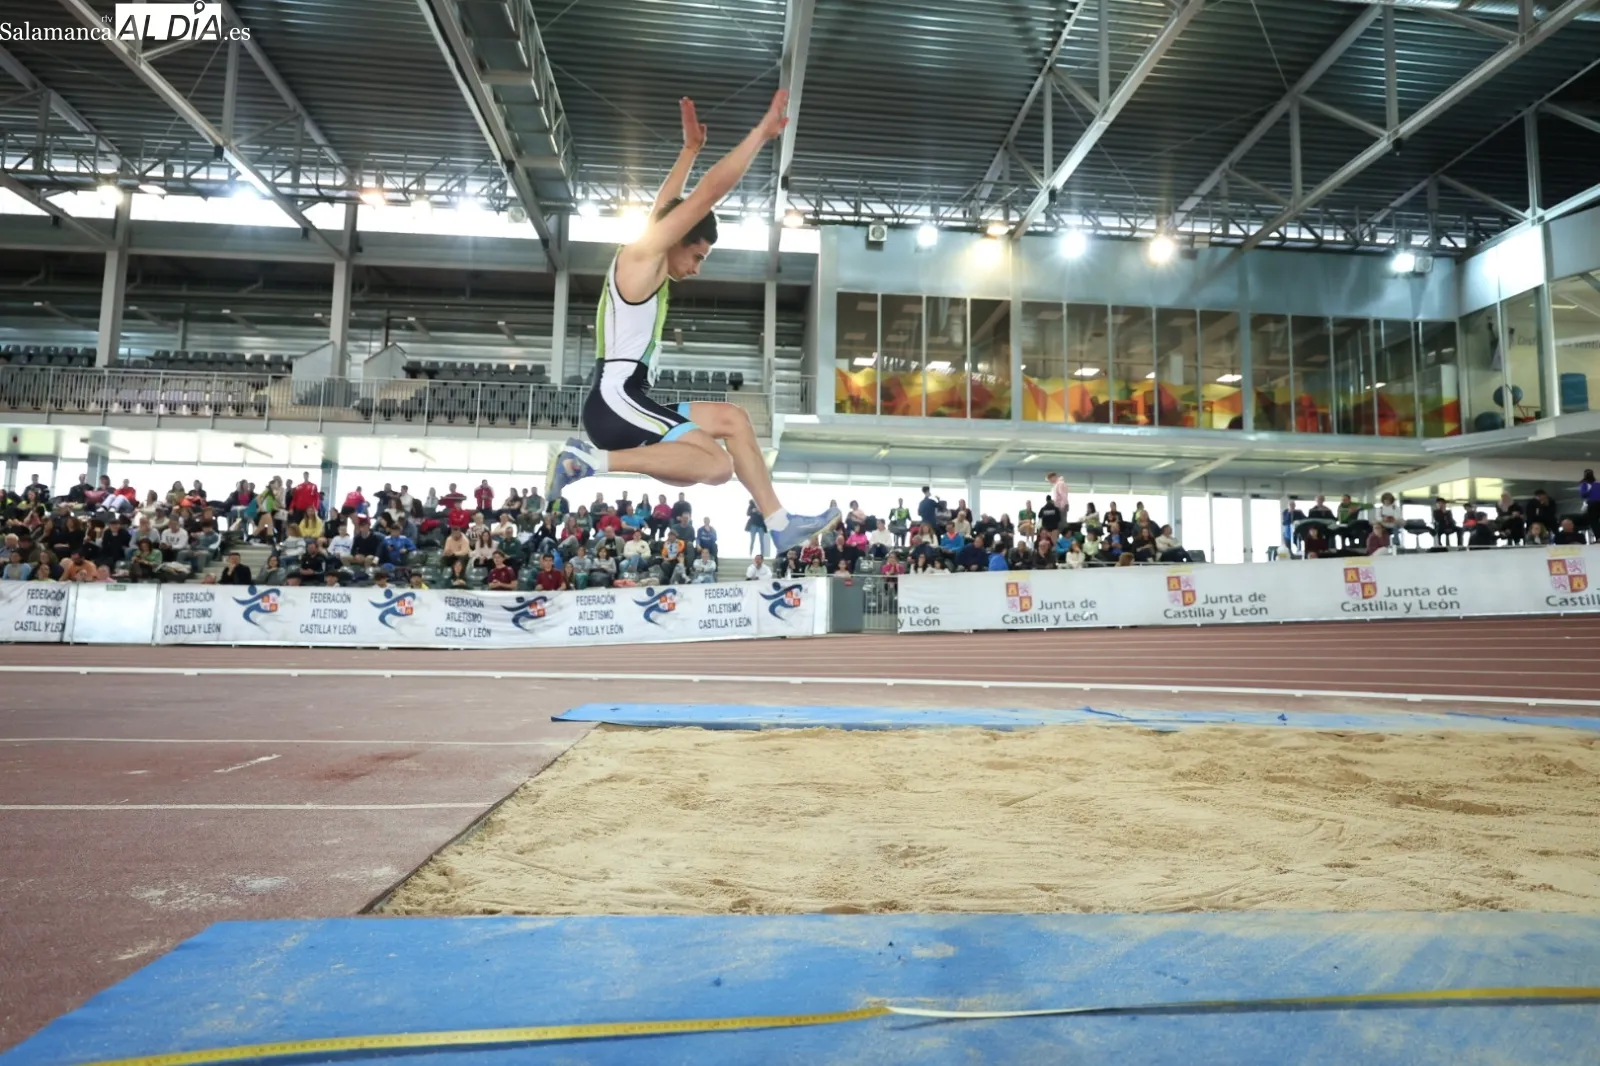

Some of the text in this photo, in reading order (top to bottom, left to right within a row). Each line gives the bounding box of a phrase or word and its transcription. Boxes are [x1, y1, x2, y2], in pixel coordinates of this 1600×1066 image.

[173, 589, 215, 604] FEDERACIÓN
[310, 590, 352, 604] FEDERACIÓN
[704, 586, 744, 600] FEDERACIÓN
[1384, 584, 1458, 598] Junta de
[444, 596, 484, 608] FEDERACIÓN
[576, 592, 616, 606] FEDERACIÓN
[1038, 598, 1097, 611] Junta de
[1202, 591, 1267, 605] Junta de
[1545, 594, 1600, 607] Castill
[707, 602, 742, 614] ATLETISMO
[923, 604, 940, 615] de
[1163, 604, 1268, 620] Castilla y León
[1340, 598, 1460, 614] Castilla y León
[175, 607, 212, 619] ATLETISMO
[311, 608, 348, 619] ATLETISMO
[446, 611, 482, 623] ATLETISMO
[578, 609, 614, 621] ATLETISMO
[1001, 613, 1049, 625] Castilla
[1052, 614, 1061, 626] y
[698, 615, 752, 630] CASTILLA Y LEÓN
[909, 616, 941, 627] León
[163, 622, 222, 635] CASTILLA Y LEÓN
[299, 622, 357, 635] CASTILLA Y LEÓN
[434, 625, 492, 638] CASTILLA Y LEÓN
[568, 622, 624, 636] CASTILLA Y LEÓN
